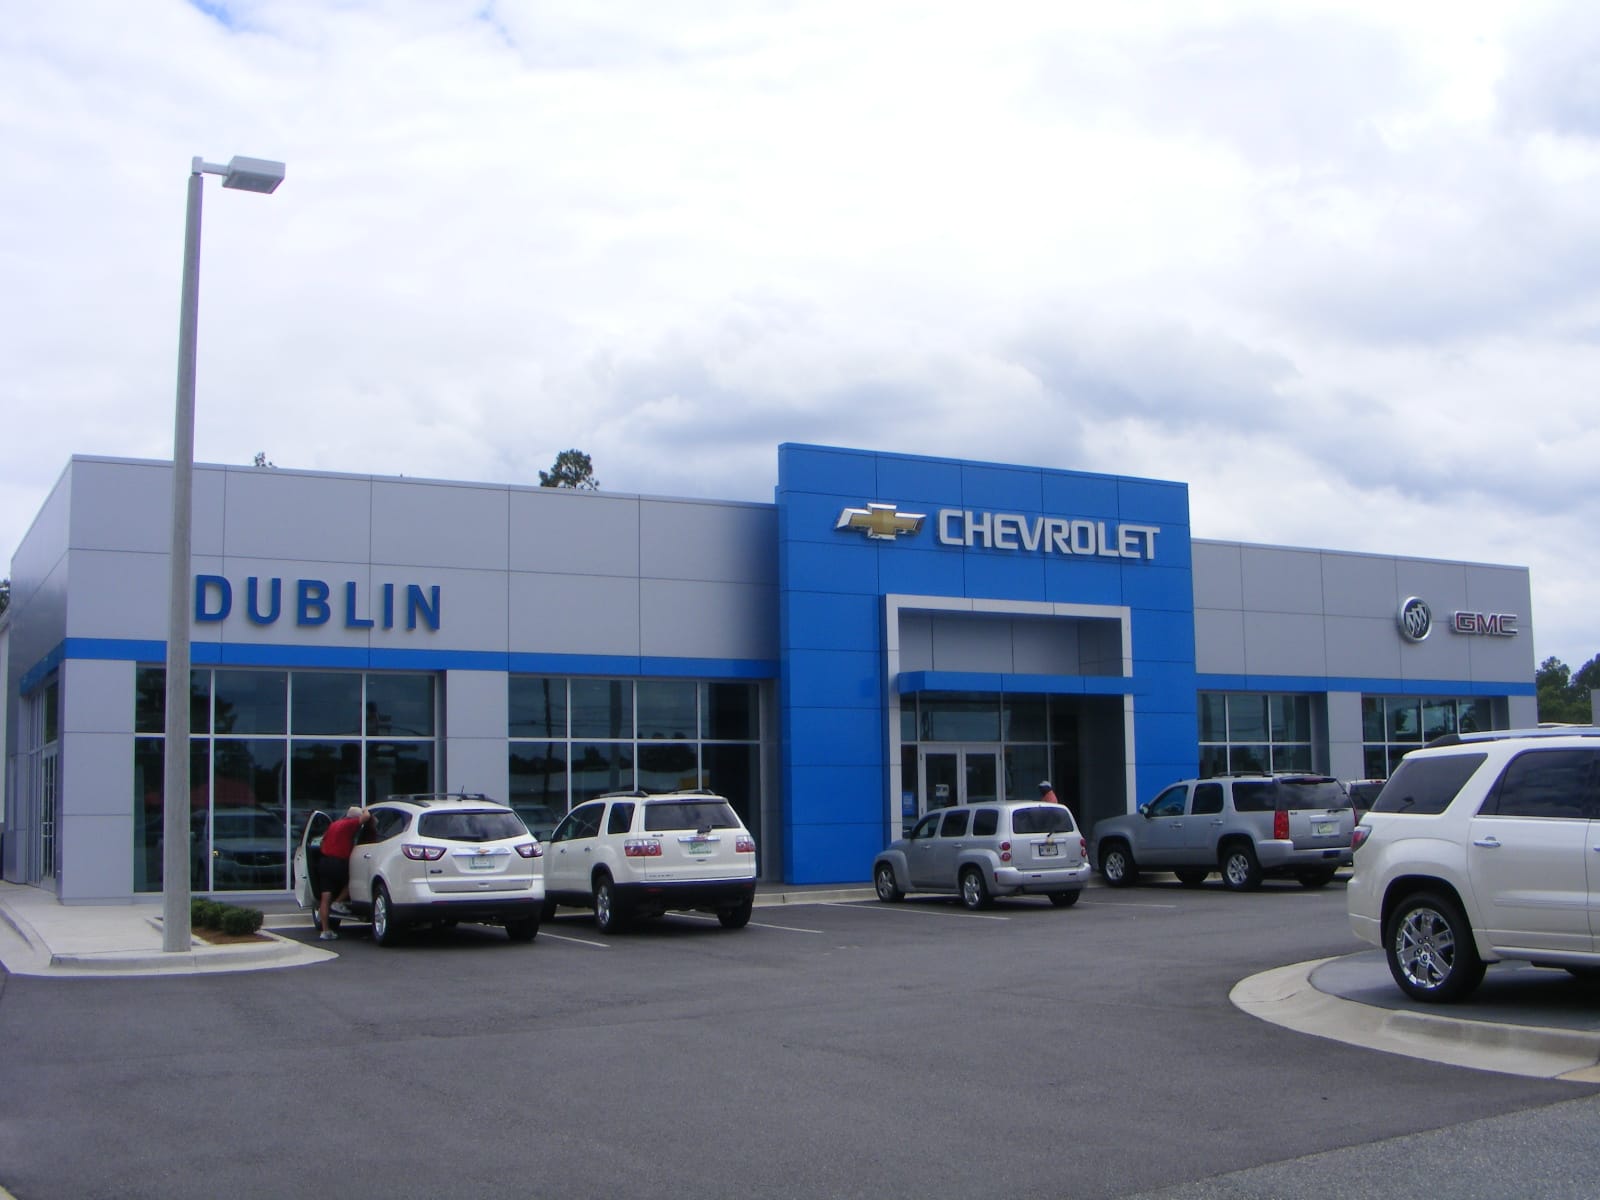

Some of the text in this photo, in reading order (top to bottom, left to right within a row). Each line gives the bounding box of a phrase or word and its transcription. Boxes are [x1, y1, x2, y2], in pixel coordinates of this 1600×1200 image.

[938, 508, 1160, 560] CHEVROLET
[195, 574, 441, 631] DUBLIN
[1454, 610, 1518, 635] GMC
